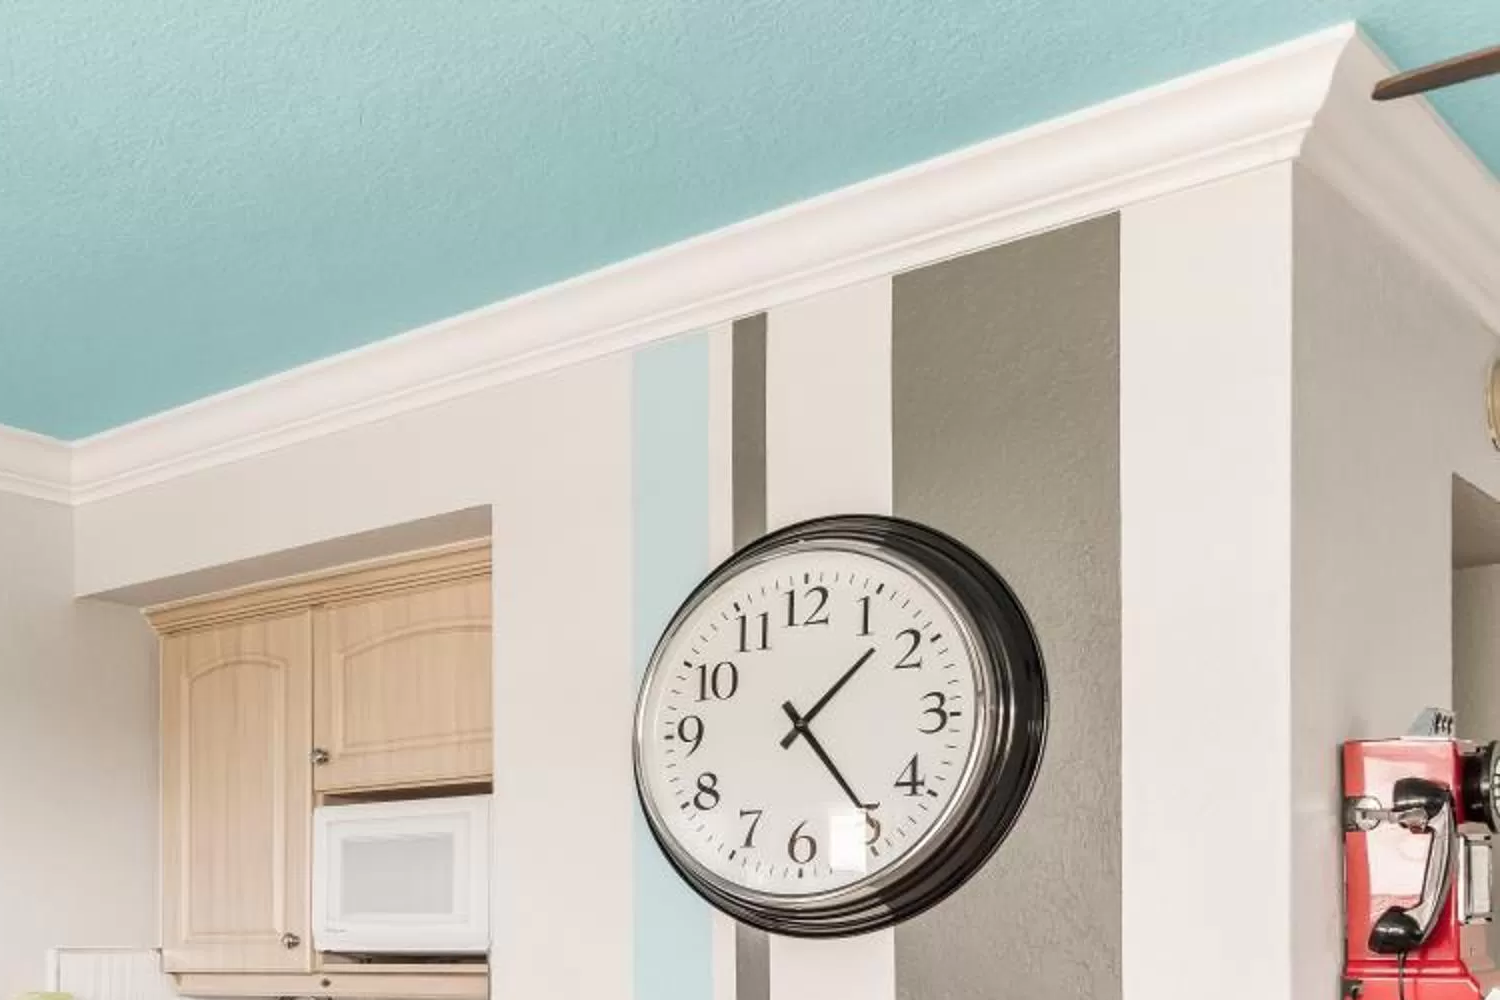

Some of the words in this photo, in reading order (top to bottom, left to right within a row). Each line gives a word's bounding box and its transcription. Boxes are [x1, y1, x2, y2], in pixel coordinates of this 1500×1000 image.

[782, 586, 831, 629] 12
[856, 596, 876, 637] 1
[737, 611, 773, 653] 11
[894, 629, 922, 669] 2
[694, 660, 739, 702] 10
[918, 691, 949, 734] 3
[677, 714, 705, 758] 9
[693, 771, 720, 812] 8
[893, 754, 926, 797] 4
[739, 808, 765, 849] 7
[787, 820, 818, 864] 6
